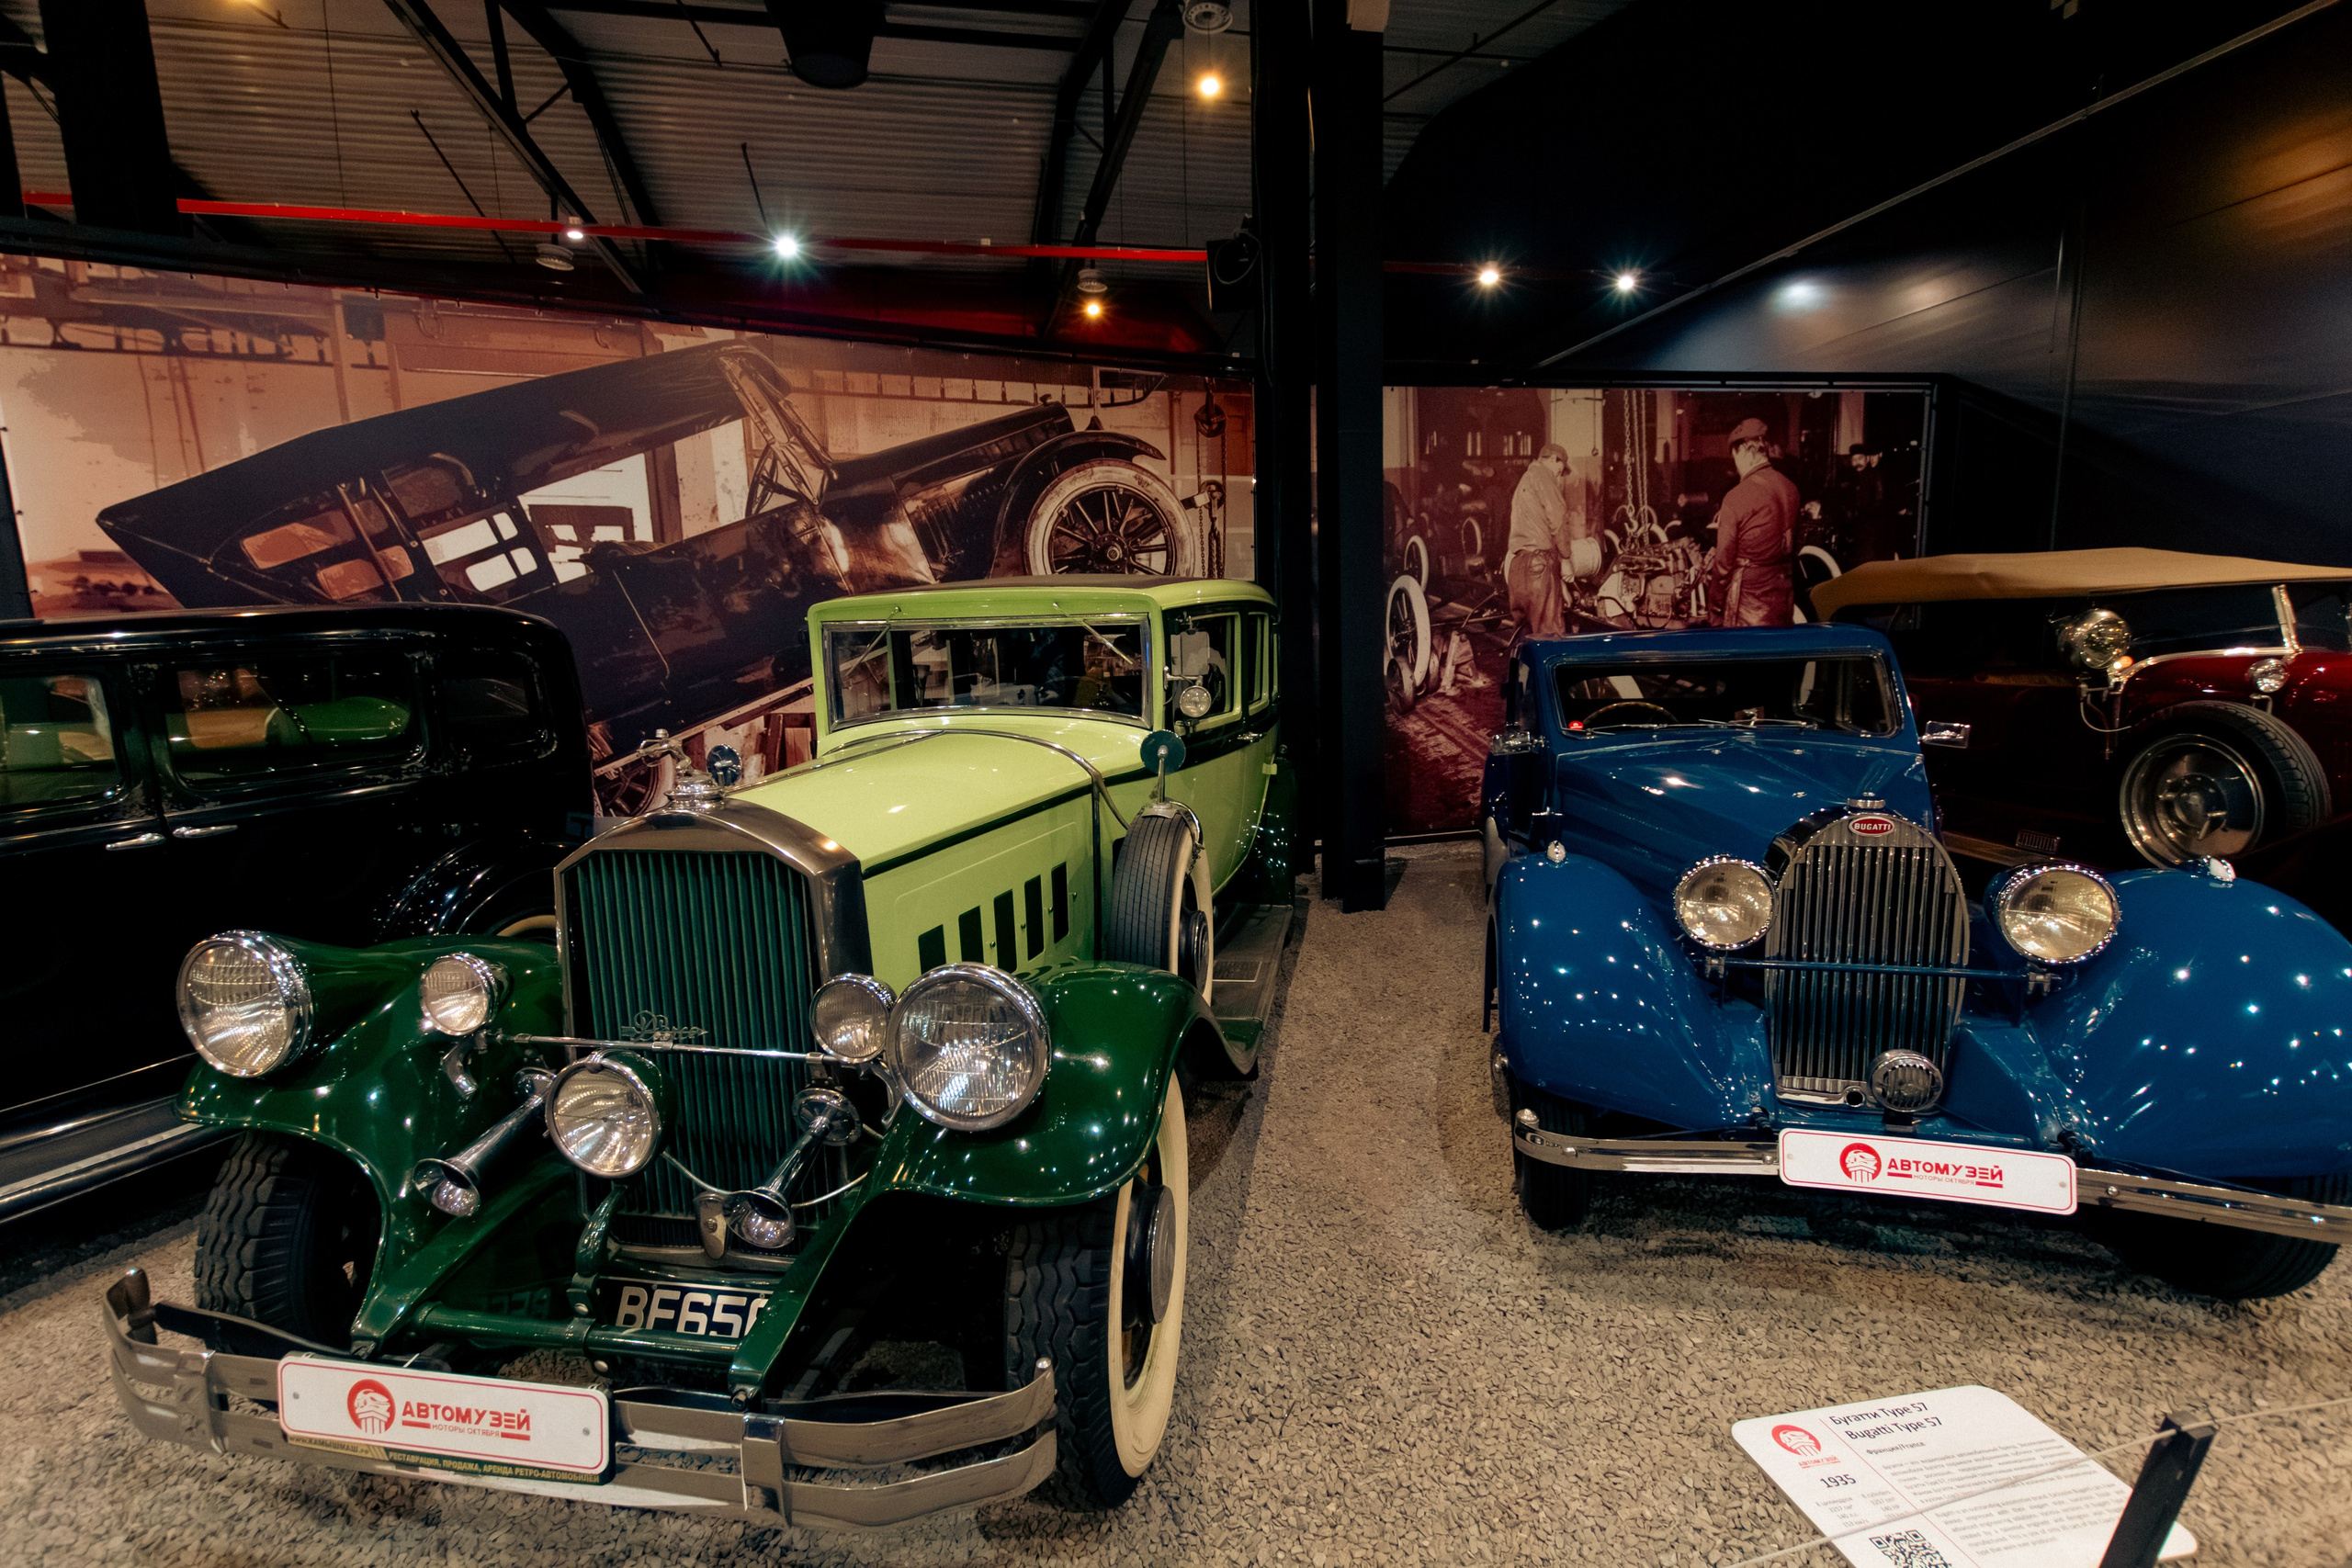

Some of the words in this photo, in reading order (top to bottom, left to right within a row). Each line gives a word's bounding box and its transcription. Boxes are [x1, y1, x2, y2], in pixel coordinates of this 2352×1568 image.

[1887, 1157, 2003, 1181] АВТОМУЗЕЙ
[401, 1401, 530, 1431] АВТОМУЗЕЙ
[1829, 1413, 1881, 1426] Бугатти
[1878, 1406, 1913, 1417] Type
[1910, 1402, 1928, 1412] 57
[432, 1424, 465, 1434] МОТОРЫ
[467, 1427, 500, 1438] ОКТЯБРЯ
[1845, 1425, 1894, 1439] Bugatti
[1891, 1420, 1927, 1433] Type
[1924, 1416, 1942, 1427] 57
[484, 1463, 513, 1475] АРЕНДА
[1820, 1473, 1857, 1488] 1935
